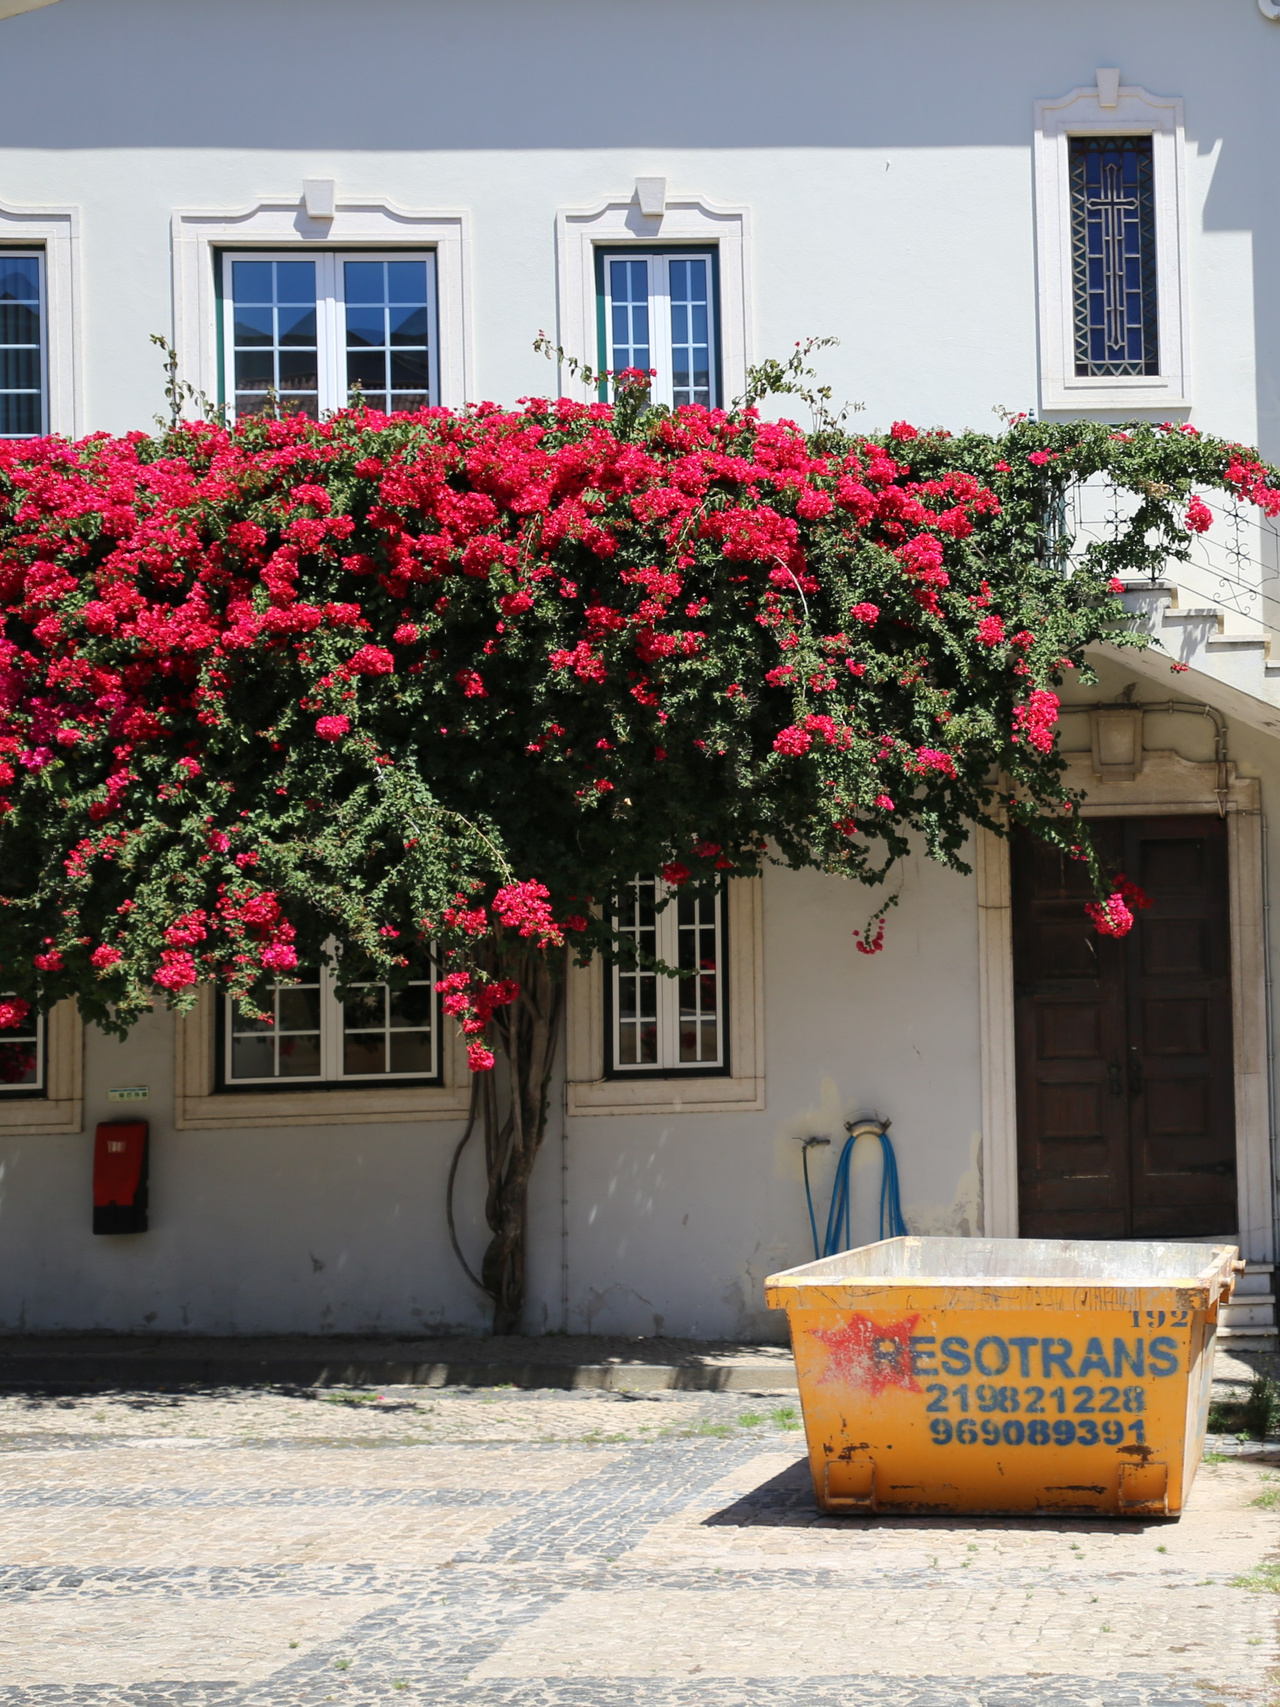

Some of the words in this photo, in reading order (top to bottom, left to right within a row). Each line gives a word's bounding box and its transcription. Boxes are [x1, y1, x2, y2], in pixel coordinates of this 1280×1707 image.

[1131, 1310, 1188, 1328] 192
[873, 1335, 1178, 1378] RESOTRANS
[926, 1383, 1145, 1413] 219821228
[929, 1418, 1145, 1446] 969089391
